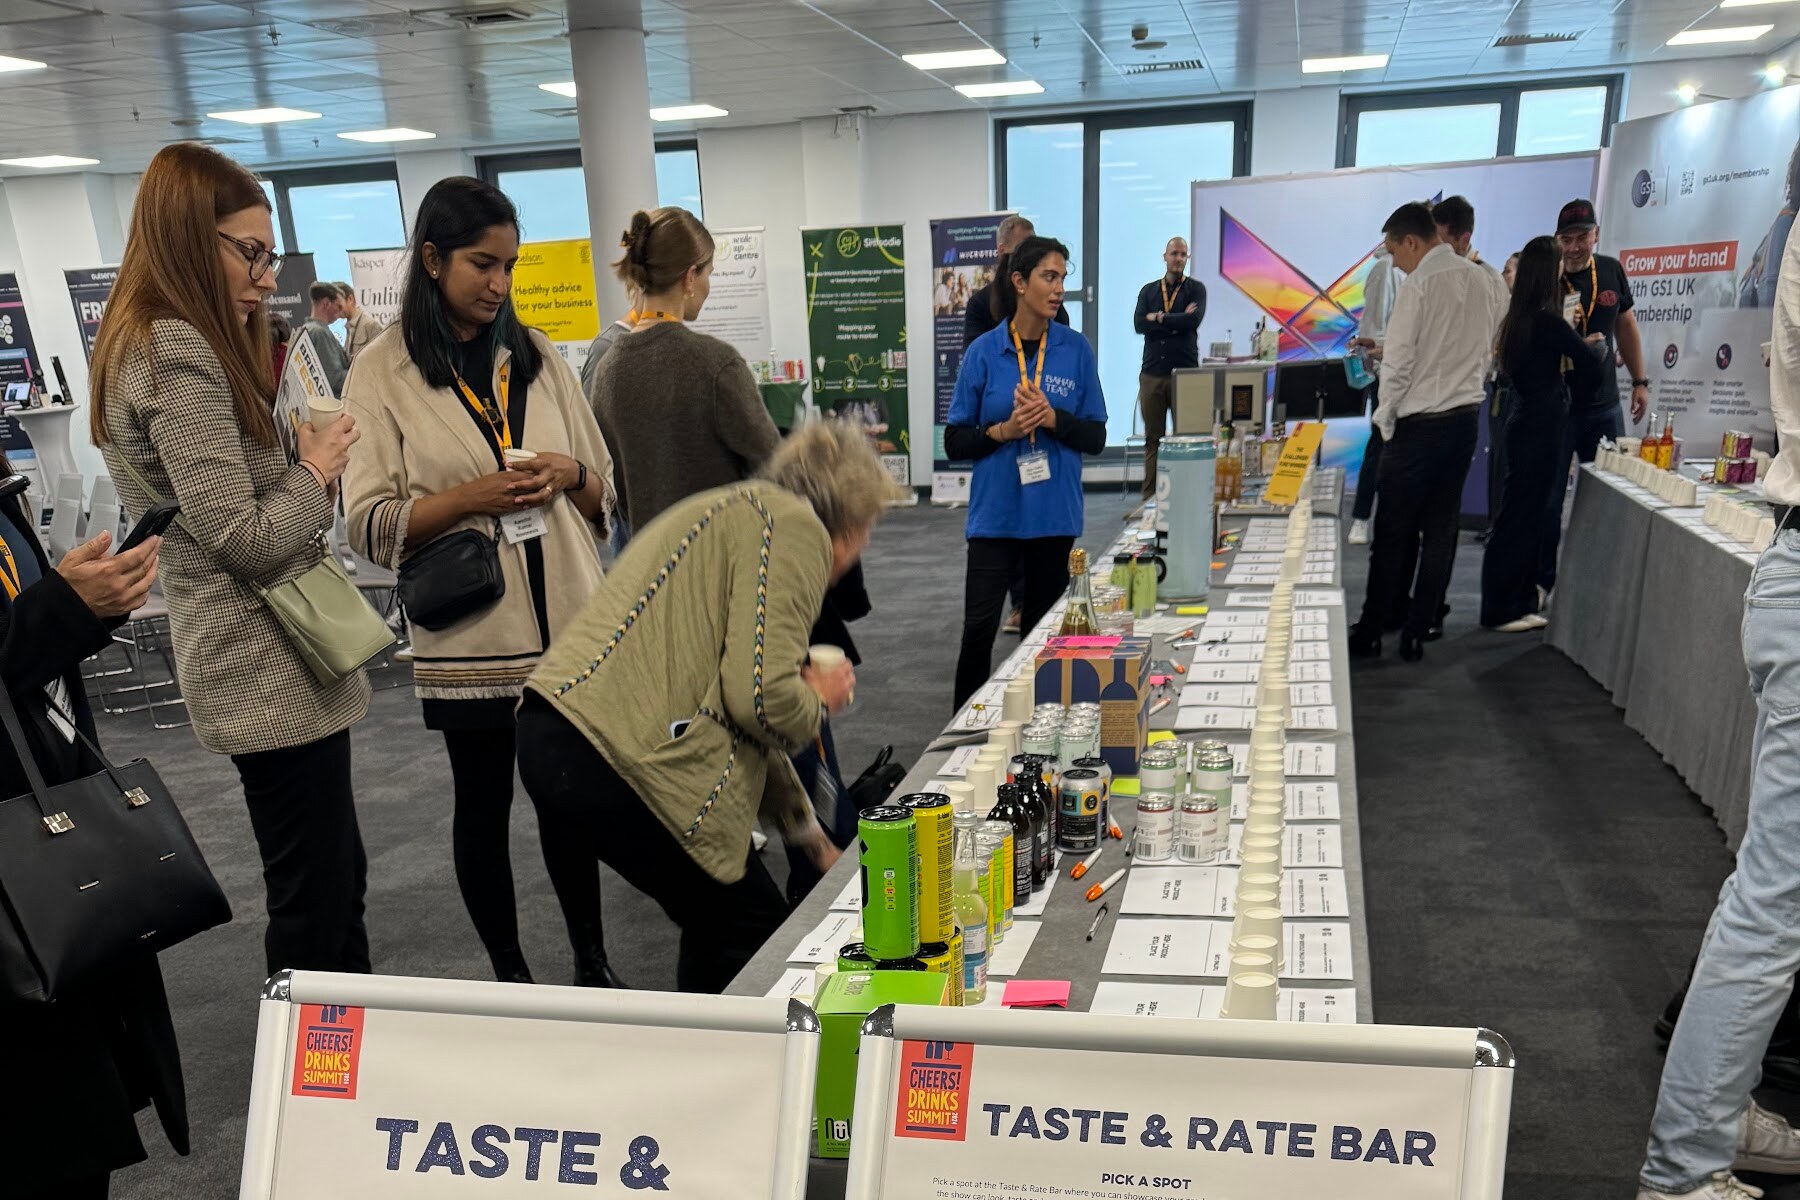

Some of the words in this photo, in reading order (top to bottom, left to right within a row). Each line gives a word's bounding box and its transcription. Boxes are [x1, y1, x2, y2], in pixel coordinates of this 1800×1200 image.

[1702, 168, 1770, 184] gs1uk.org/membership
[1640, 181, 1656, 194] GS1
[958, 250, 999, 260] MICROTEC
[1625, 254, 1657, 272] Grow
[1658, 254, 1686, 272] your
[1688, 246, 1728, 268] brand
[515, 284, 550, 296] Healthy
[552, 282, 582, 293] advice
[1650, 278, 1672, 297] GS1
[1676, 278, 1696, 296] UK
[516, 301, 530, 312] for
[532, 301, 552, 312] your
[554, 298, 593, 308] business
[1151, 936, 1160, 946] YOUR
[1149, 946, 1158, 957] PLACE
[1160, 944, 1170, 959] PRODUCT
[306, 1032, 354, 1052] CHEERS!
[304, 1050, 351, 1072] DRINKS
[303, 1071, 344, 1084] SUMMIT
[910, 1069, 961, 1090] CHEERS!
[908, 1088, 959, 1111] DRINKS
[907, 1110, 951, 1125] SUMMIT
[982, 1102, 1129, 1145] TASTE
[1139, 1113, 1173, 1149] &
[1186, 1116, 1317, 1158] RATE
[1330, 1125, 1436, 1167] BAR
[375, 1116, 601, 1186] TASTE
[619, 1134, 670, 1192] &
[932, 1176, 948, 1186] Pick
[956, 1180, 973, 1188] spot
[974, 1181, 982, 1189] at
[984, 1181, 997, 1190] the
[999, 1181, 1020, 1191] Taste
[1020, 1183, 1028, 1192] &
[1029, 1184, 1048, 1194] Rate
[1049, 1185, 1062, 1195] Bar
[1064, 1187, 1089, 1197] where
[1090, 1191, 1106, 1199] you
[1101, 1172, 1134, 1186] PICK
[1137, 1175, 1149, 1187] A
[1152, 1176, 1192, 1190] SPOT
[936, 1189, 949, 1198] the
[950, 1190, 972, 1200] show
